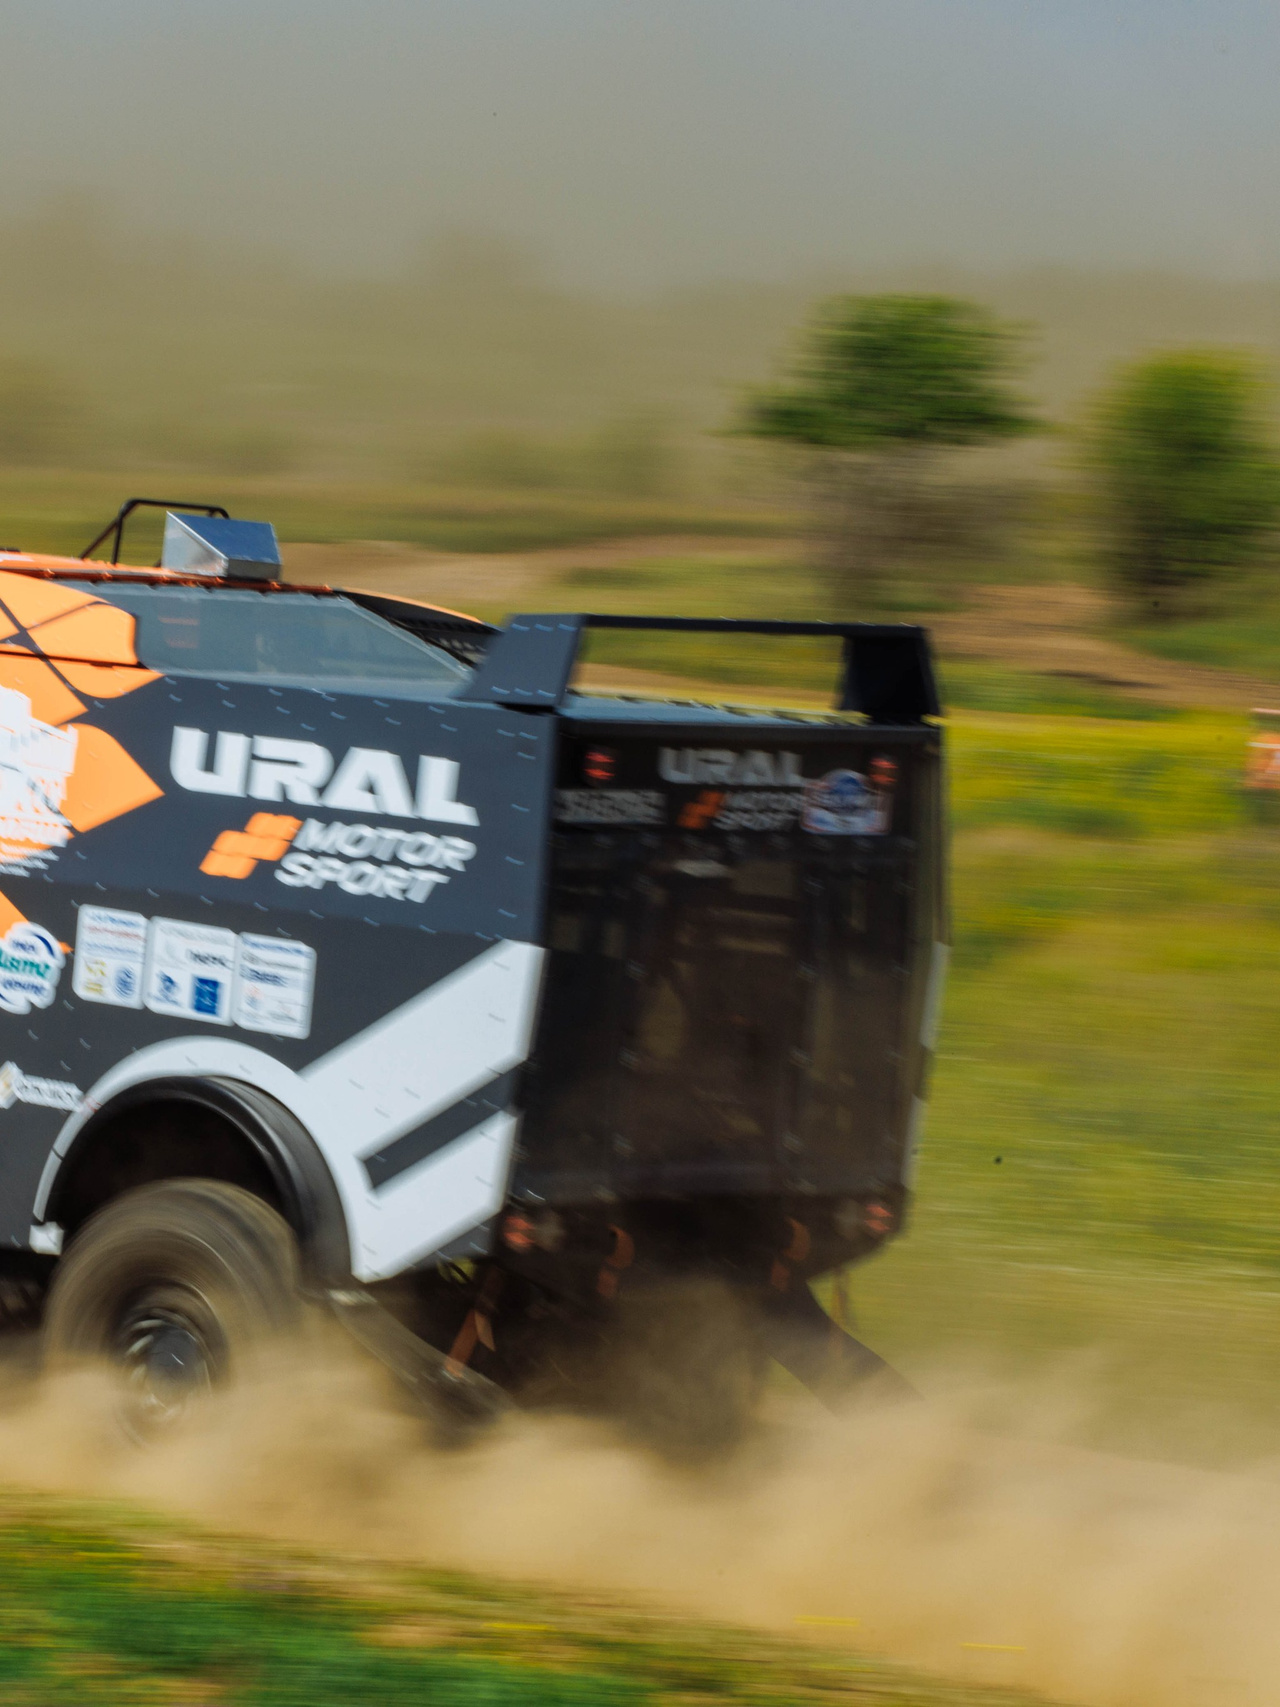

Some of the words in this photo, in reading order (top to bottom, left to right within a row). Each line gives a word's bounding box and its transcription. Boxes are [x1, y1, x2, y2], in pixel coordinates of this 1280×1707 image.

[170, 726, 480, 827] URAL
[657, 746, 812, 787] URAL
[291, 817, 477, 872] MOTOR
[274, 852, 451, 904] SPORT
